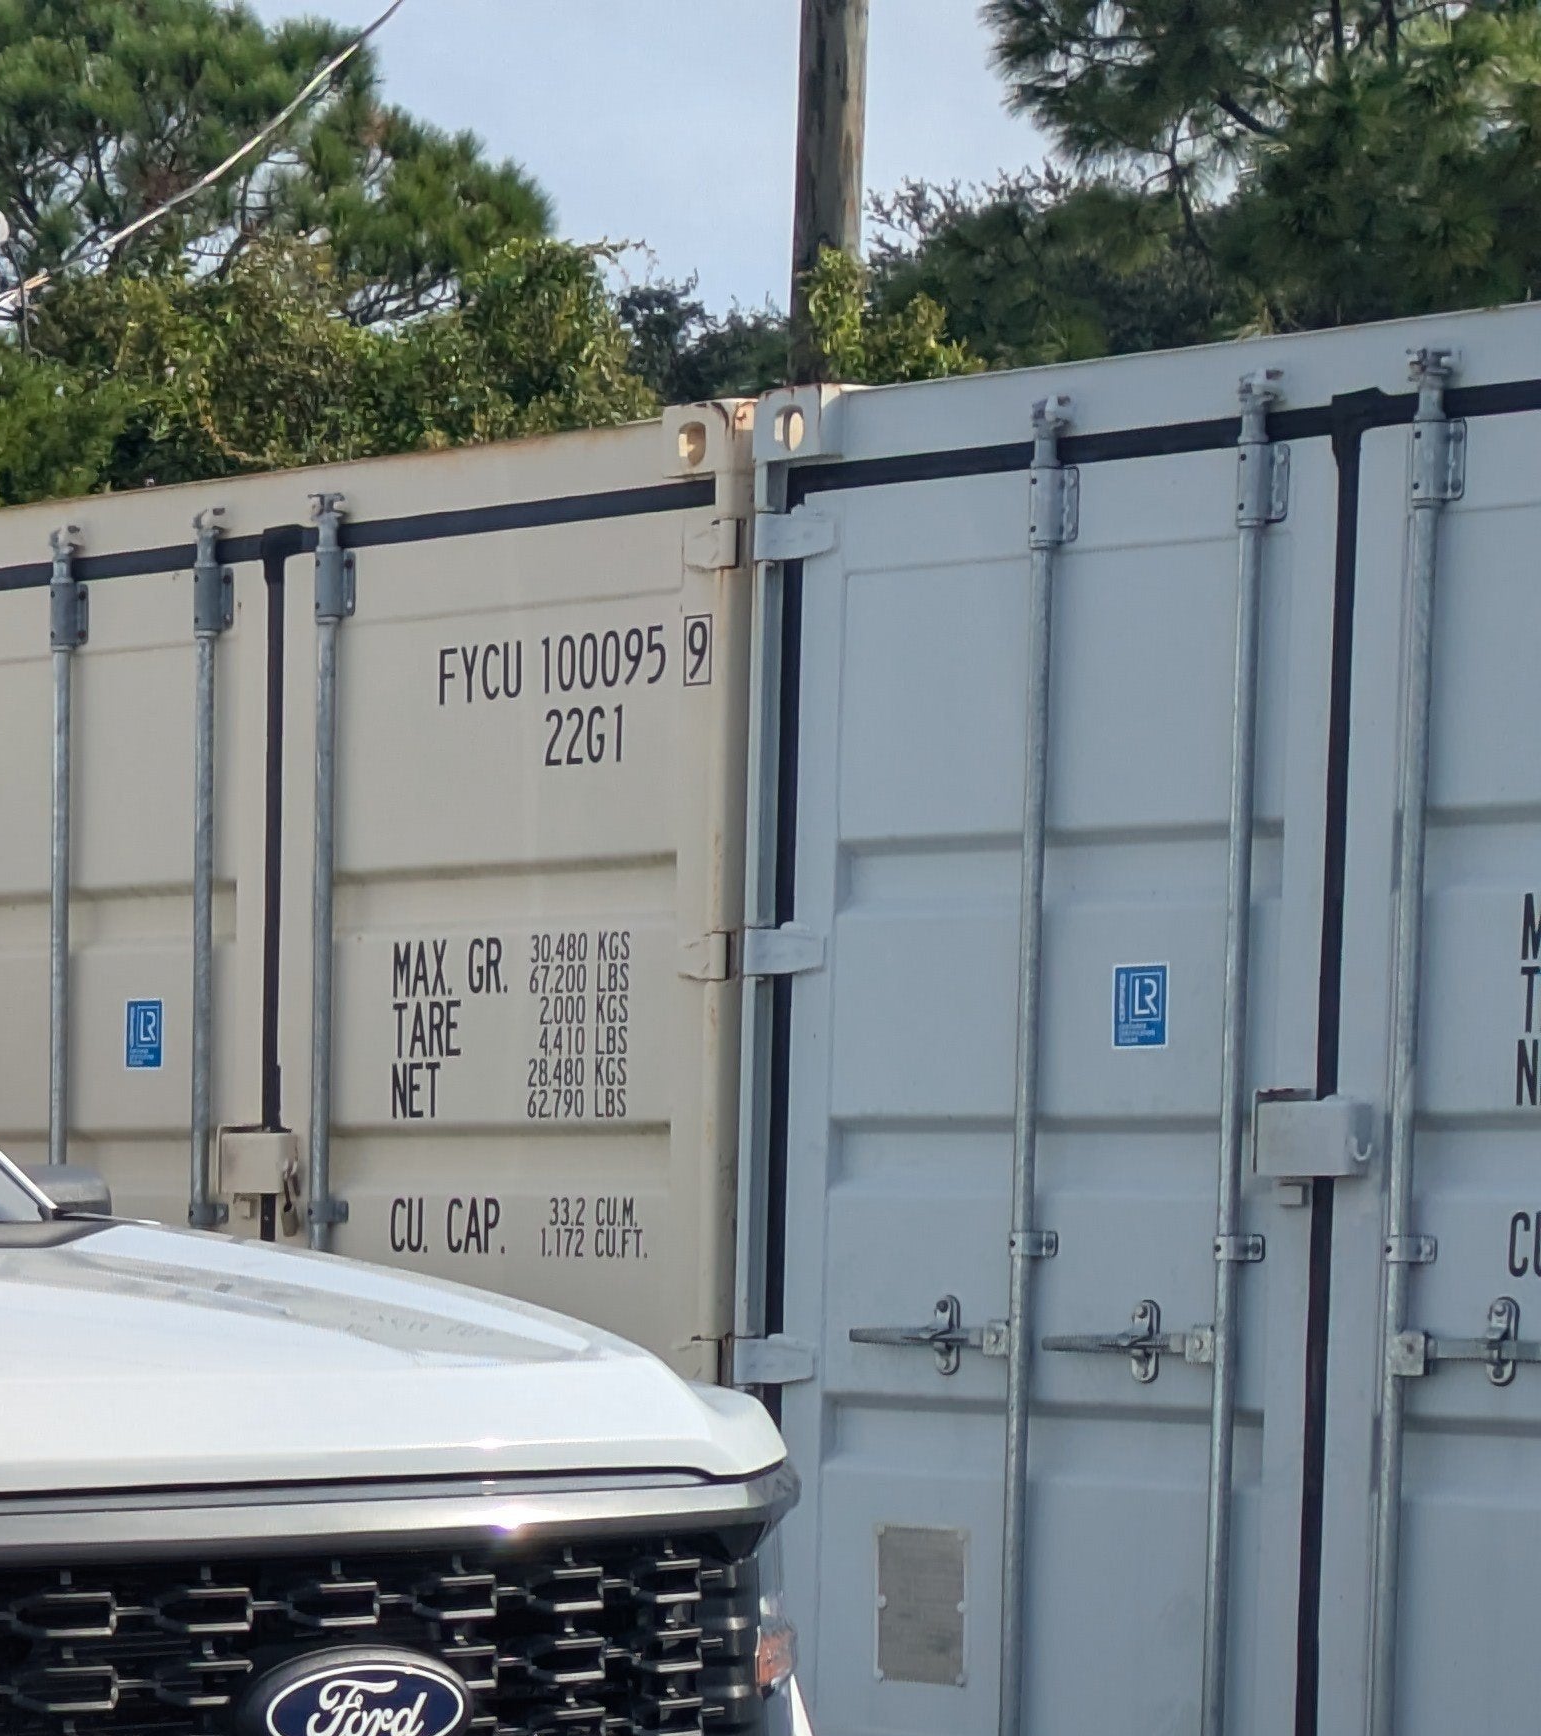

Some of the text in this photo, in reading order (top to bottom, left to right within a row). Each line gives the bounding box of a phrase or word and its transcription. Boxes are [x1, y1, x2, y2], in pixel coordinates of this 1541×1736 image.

[439, 620, 708, 705] FYCU 100095 9
[544, 704, 623, 766] 22G1
[392, 938, 453, 998] MAX.
[468, 937, 509, 994] GR.
[597, 931, 631, 962] KGS
[596, 962, 630, 993] LBS
[393, 1000, 461, 1058] TARE
[596, 994, 629, 1024] KGS
[595, 1025, 628, 1055] LBS
[391, 1062, 441, 1118] NET
[594, 1057, 627, 1087] KGS
[594, 1088, 627, 1118] LBS
[390, 1198, 428, 1254] CU.
[447, 1198, 506, 1254] CAP.
[549, 1197, 586, 1227] 33.2
[541, 1228, 585, 1258] 1.172
